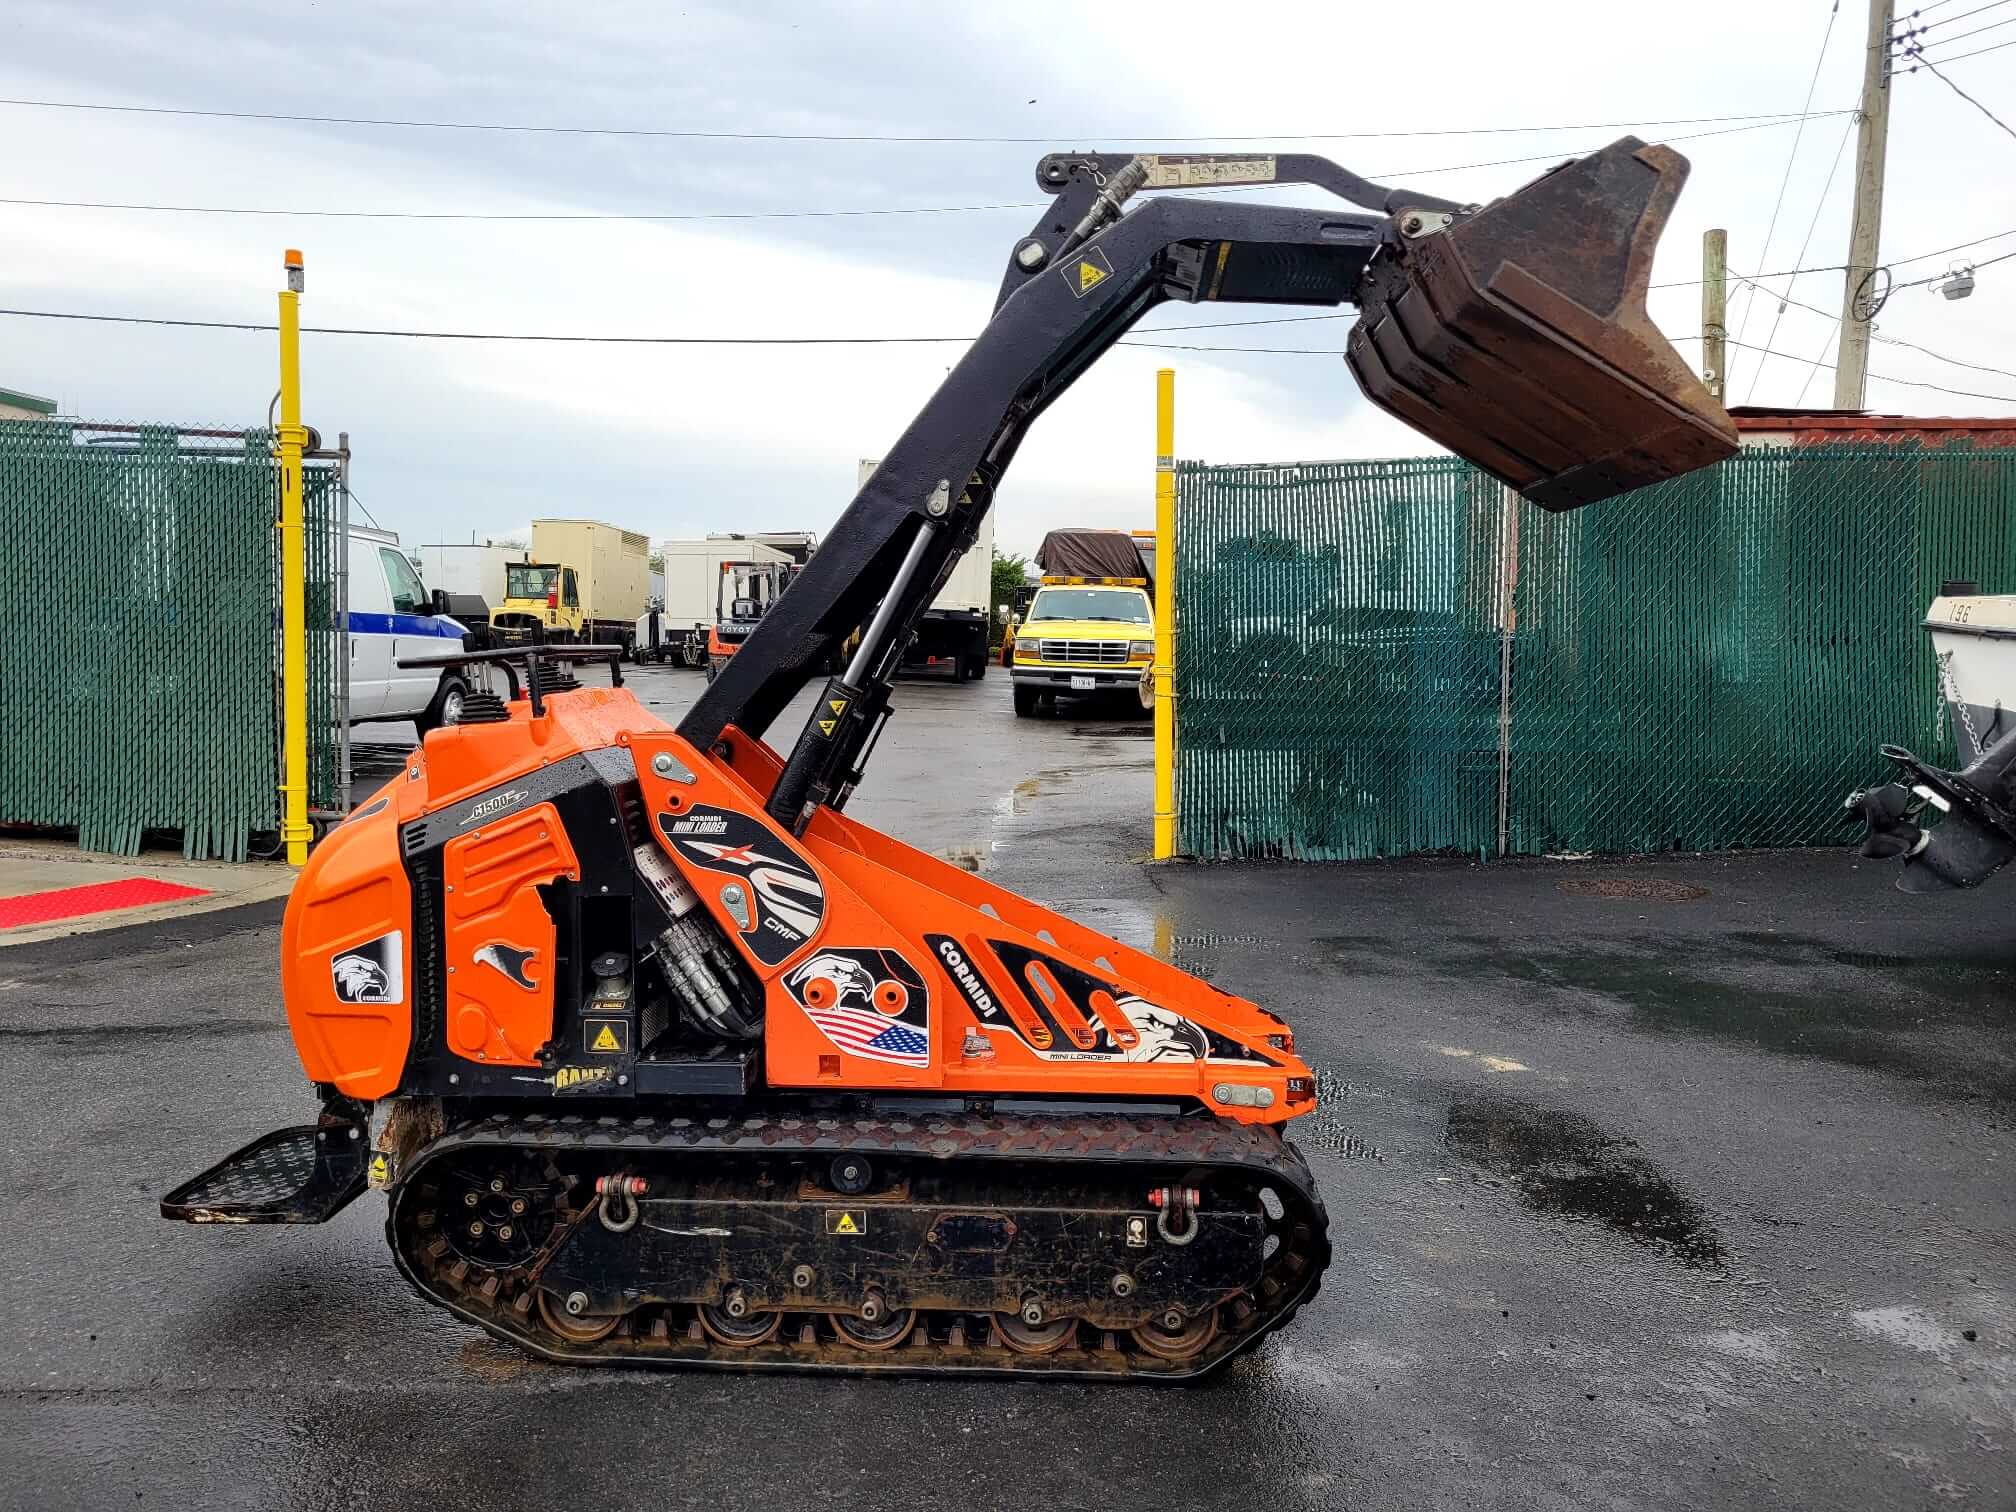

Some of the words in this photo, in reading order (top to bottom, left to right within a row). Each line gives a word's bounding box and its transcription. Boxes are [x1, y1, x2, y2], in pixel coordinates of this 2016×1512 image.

[672, 821, 695, 833] MINI
[693, 821, 728, 833] LOADER
[763, 916, 801, 941] CMF
[939, 941, 998, 1018] CORMIDI
